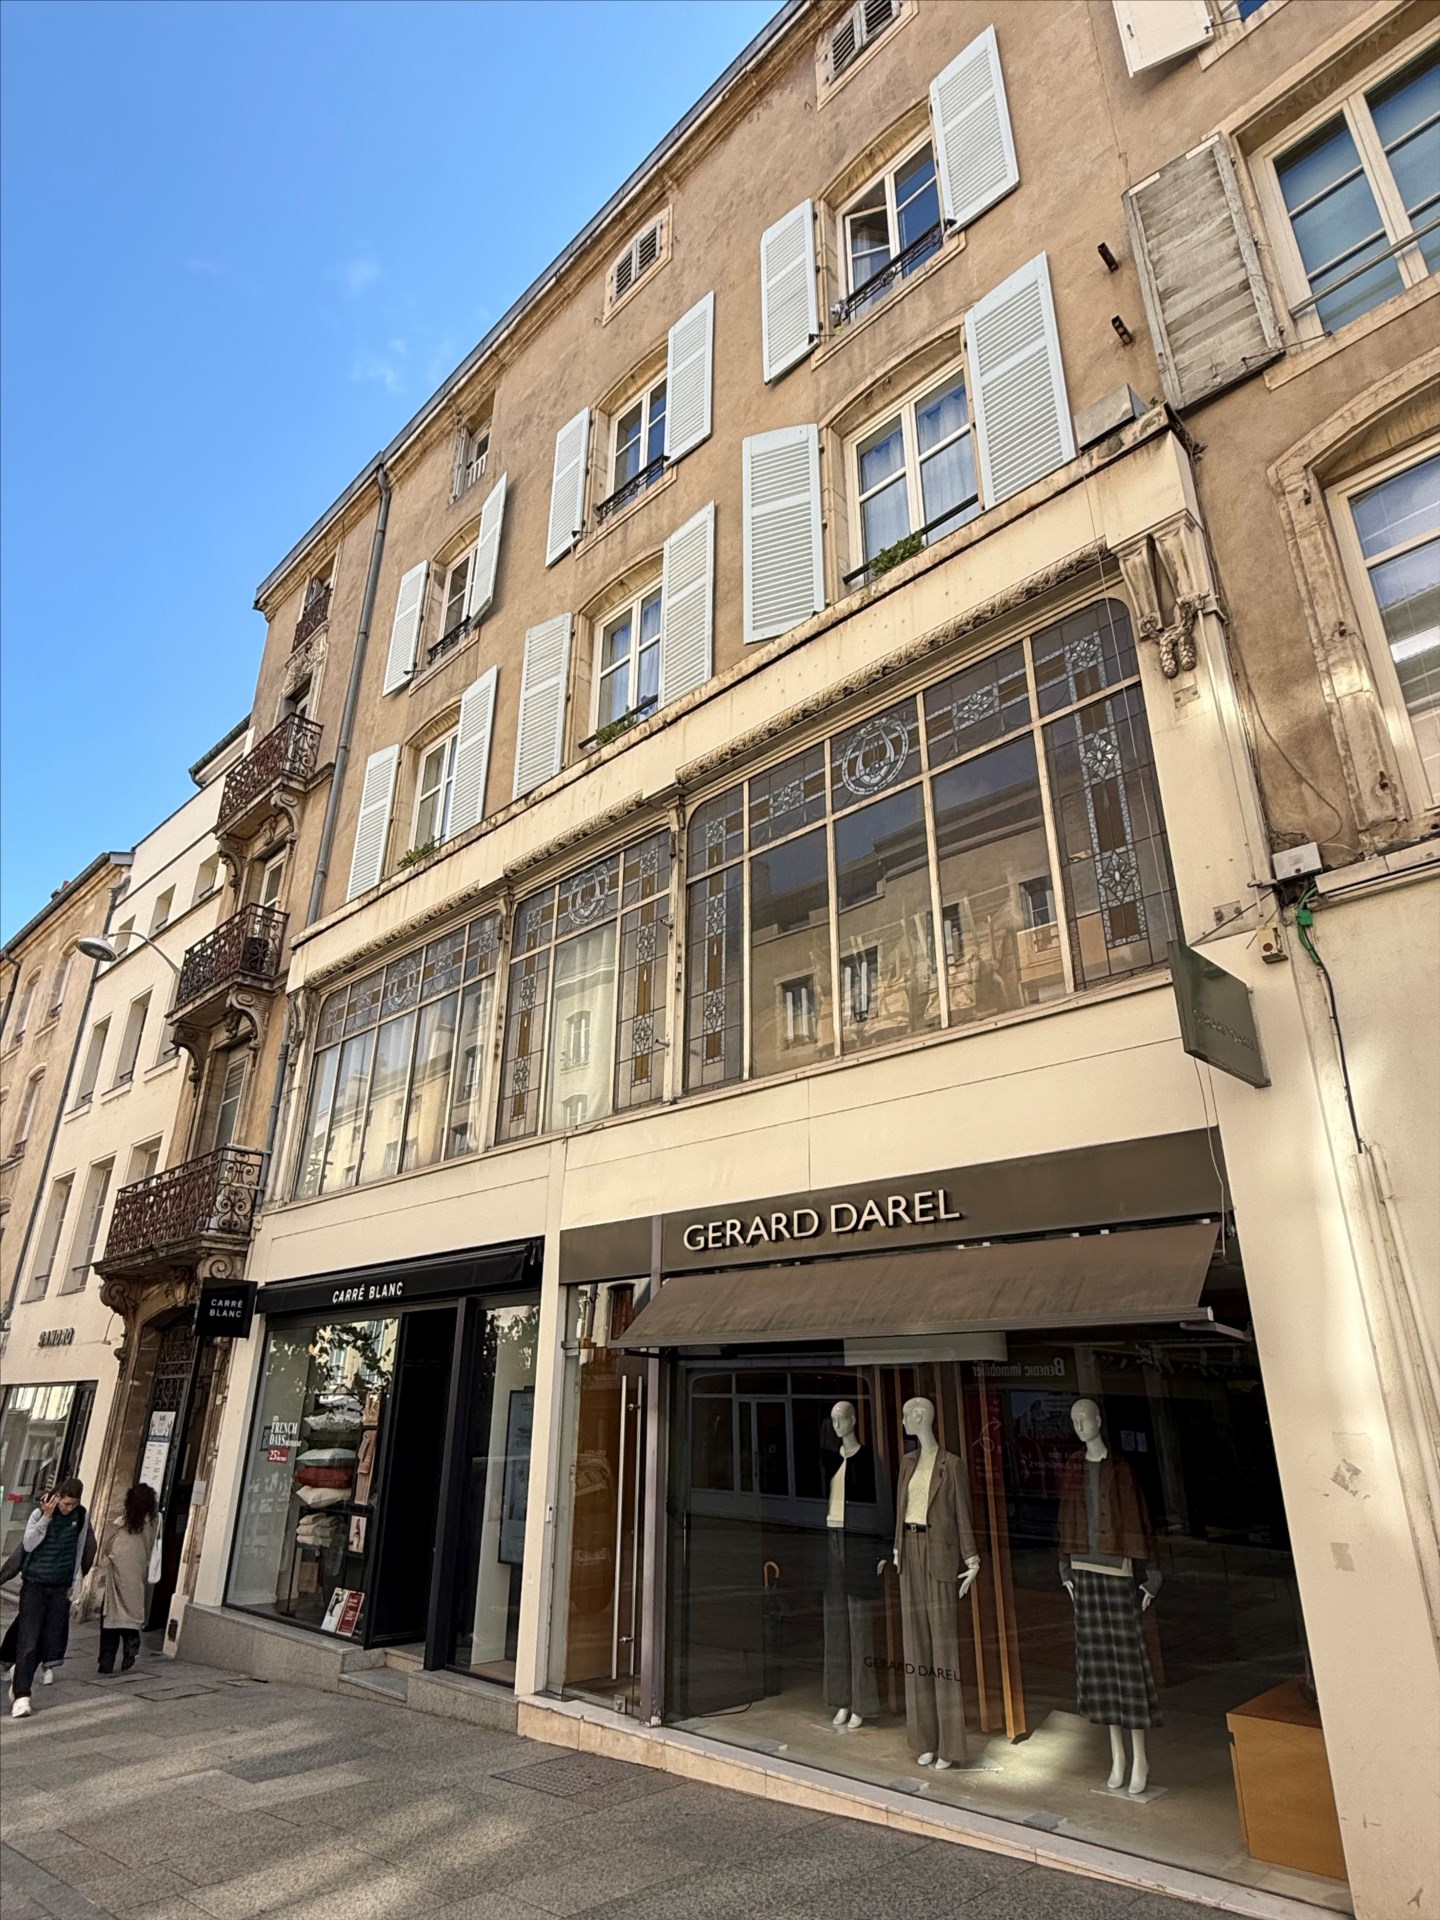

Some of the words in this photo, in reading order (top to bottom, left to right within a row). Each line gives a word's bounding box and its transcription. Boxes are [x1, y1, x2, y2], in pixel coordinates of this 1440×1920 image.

[683, 1208, 819, 1251] GERARD
[830, 1189, 961, 1233] DAREL
[332, 1283, 365, 1304] CARRÉ
[368, 1281, 403, 1300] BLANC
[210, 1298, 243, 1308] CARRÉ
[209, 1309, 242, 1318] BLANC
[38, 1327, 75, 1348] SANDRO
[271, 1422, 298, 1435] FRENCH
[269, 1434, 286, 1446] DAYS
[863, 1656, 915, 1675] GERARD
[918, 1664, 961, 1682] DAREL
